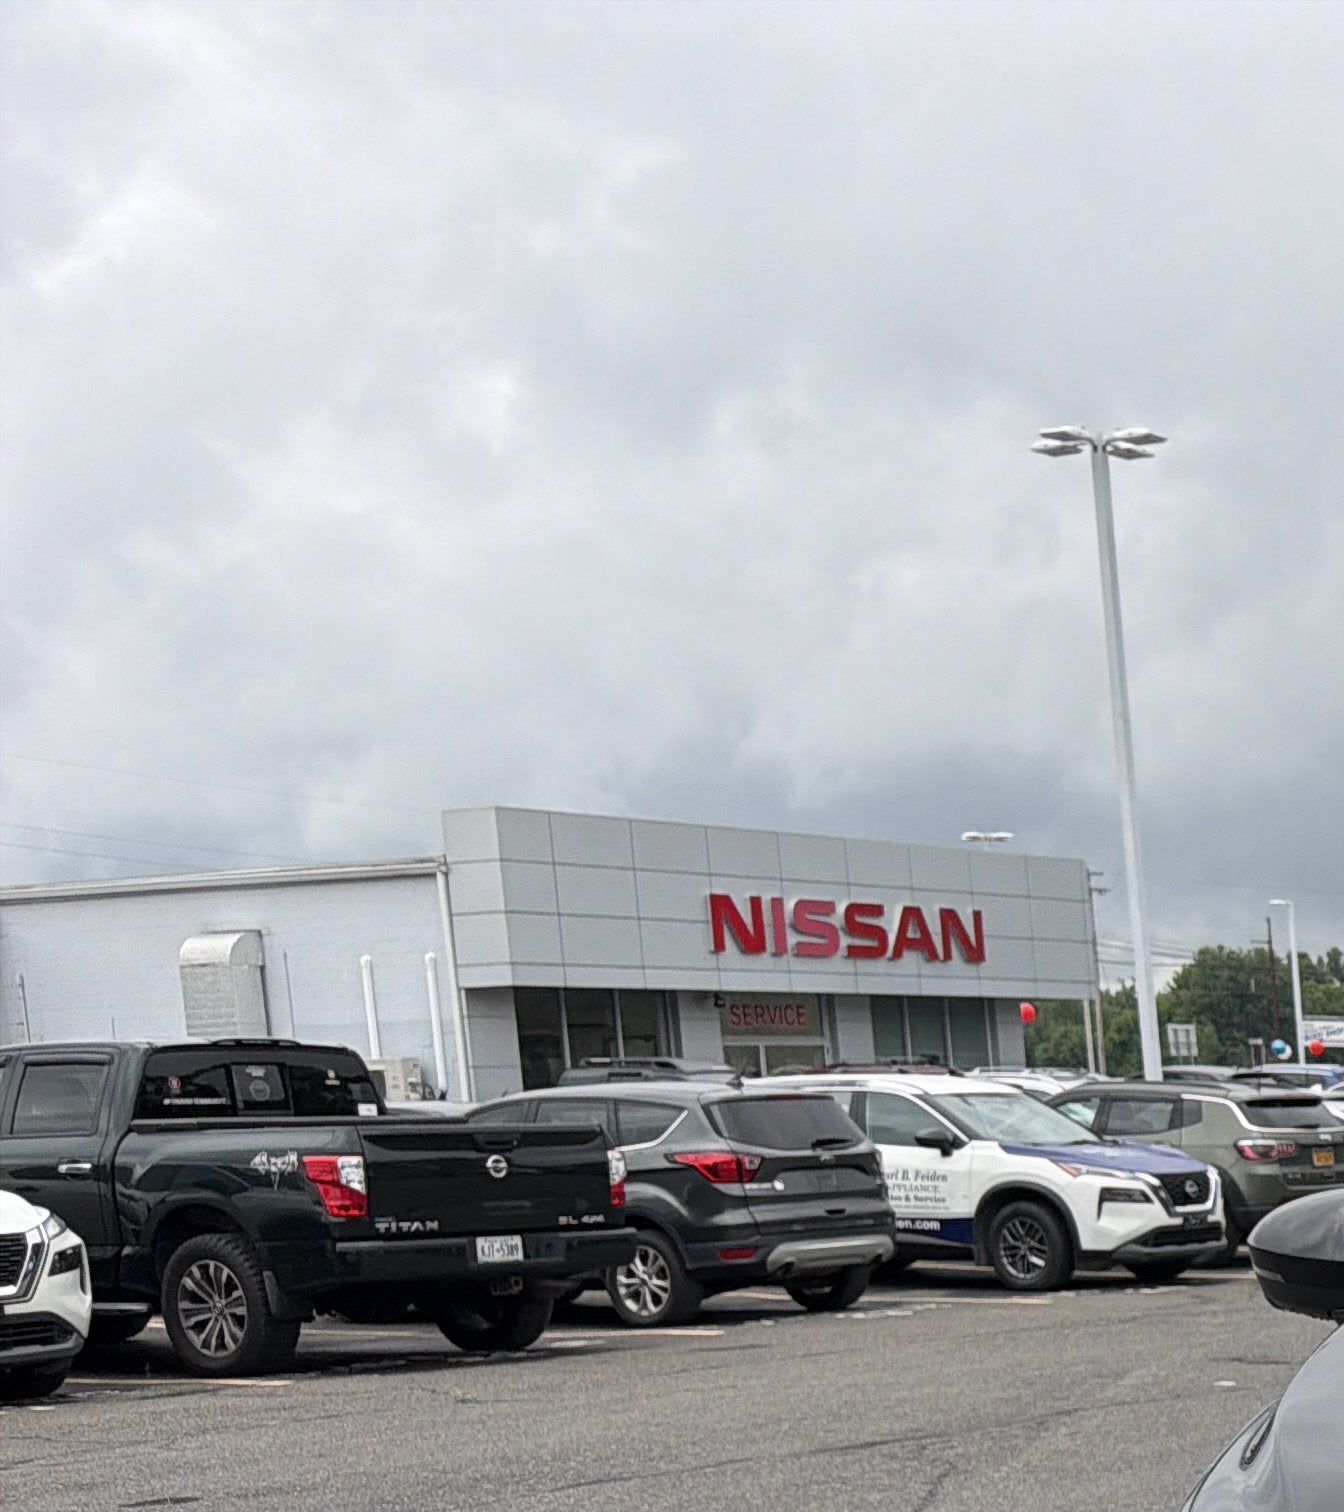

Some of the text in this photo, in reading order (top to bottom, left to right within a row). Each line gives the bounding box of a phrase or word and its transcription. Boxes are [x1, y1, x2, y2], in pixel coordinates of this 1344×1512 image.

[708, 892, 986, 965] NISSAN
[730, 1003, 807, 1027] SERVICE
[374, 1220, 439, 1233] TITAN
